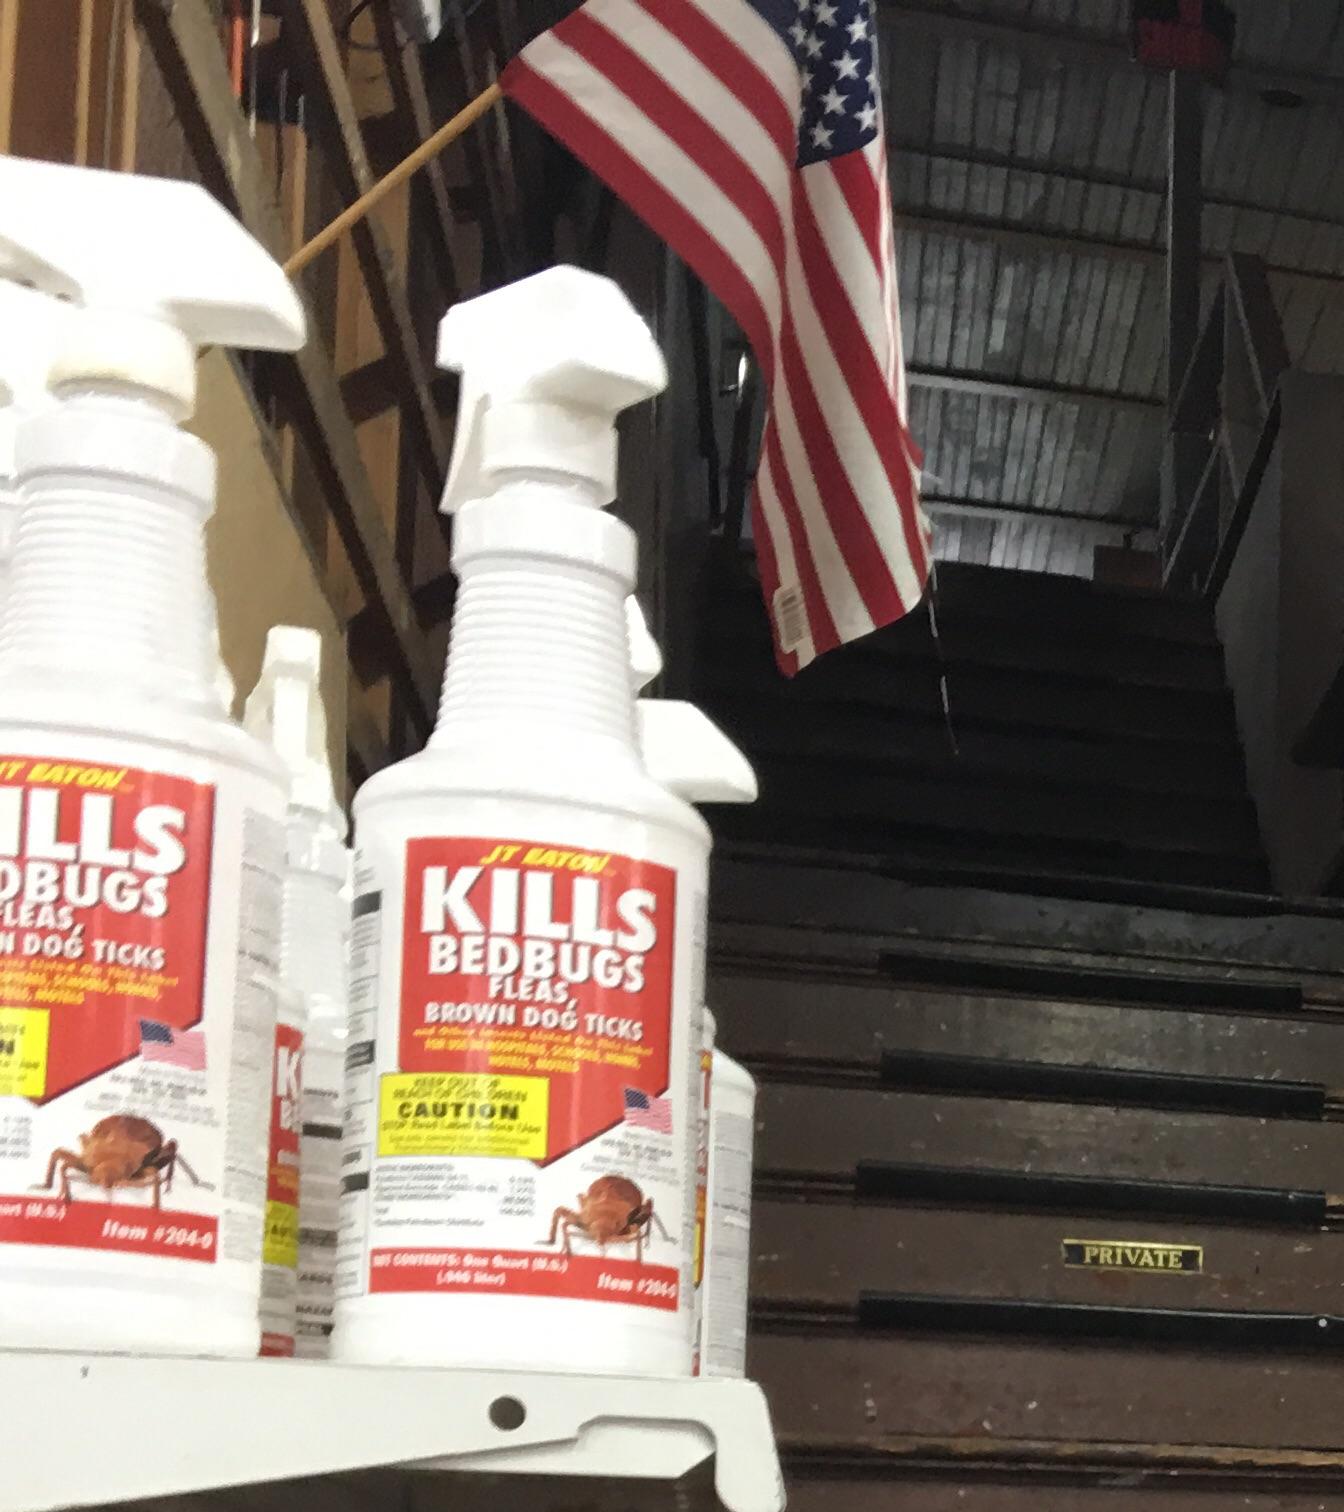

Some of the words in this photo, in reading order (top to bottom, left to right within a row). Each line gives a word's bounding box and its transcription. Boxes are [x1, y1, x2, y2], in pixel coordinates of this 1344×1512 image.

[26, 763, 128, 790] EATON
[0, 901, 85, 938] LEAS,
[421, 866, 658, 954] KILLS
[22, 932, 85, 960] DOG
[92, 939, 167, 972] TICKS
[428, 935, 646, 994] BEDBUGS
[489, 975, 578, 1011] FLEAS,
[425, 1002, 516, 1025] BROWN
[522, 1007, 579, 1032] DOG
[584, 1013, 644, 1043] TICKS
[398, 1101, 520, 1121] CAUTION
[102, 1218, 148, 1242] Item
[1083, 1246, 1183, 1269] PRIVATE
